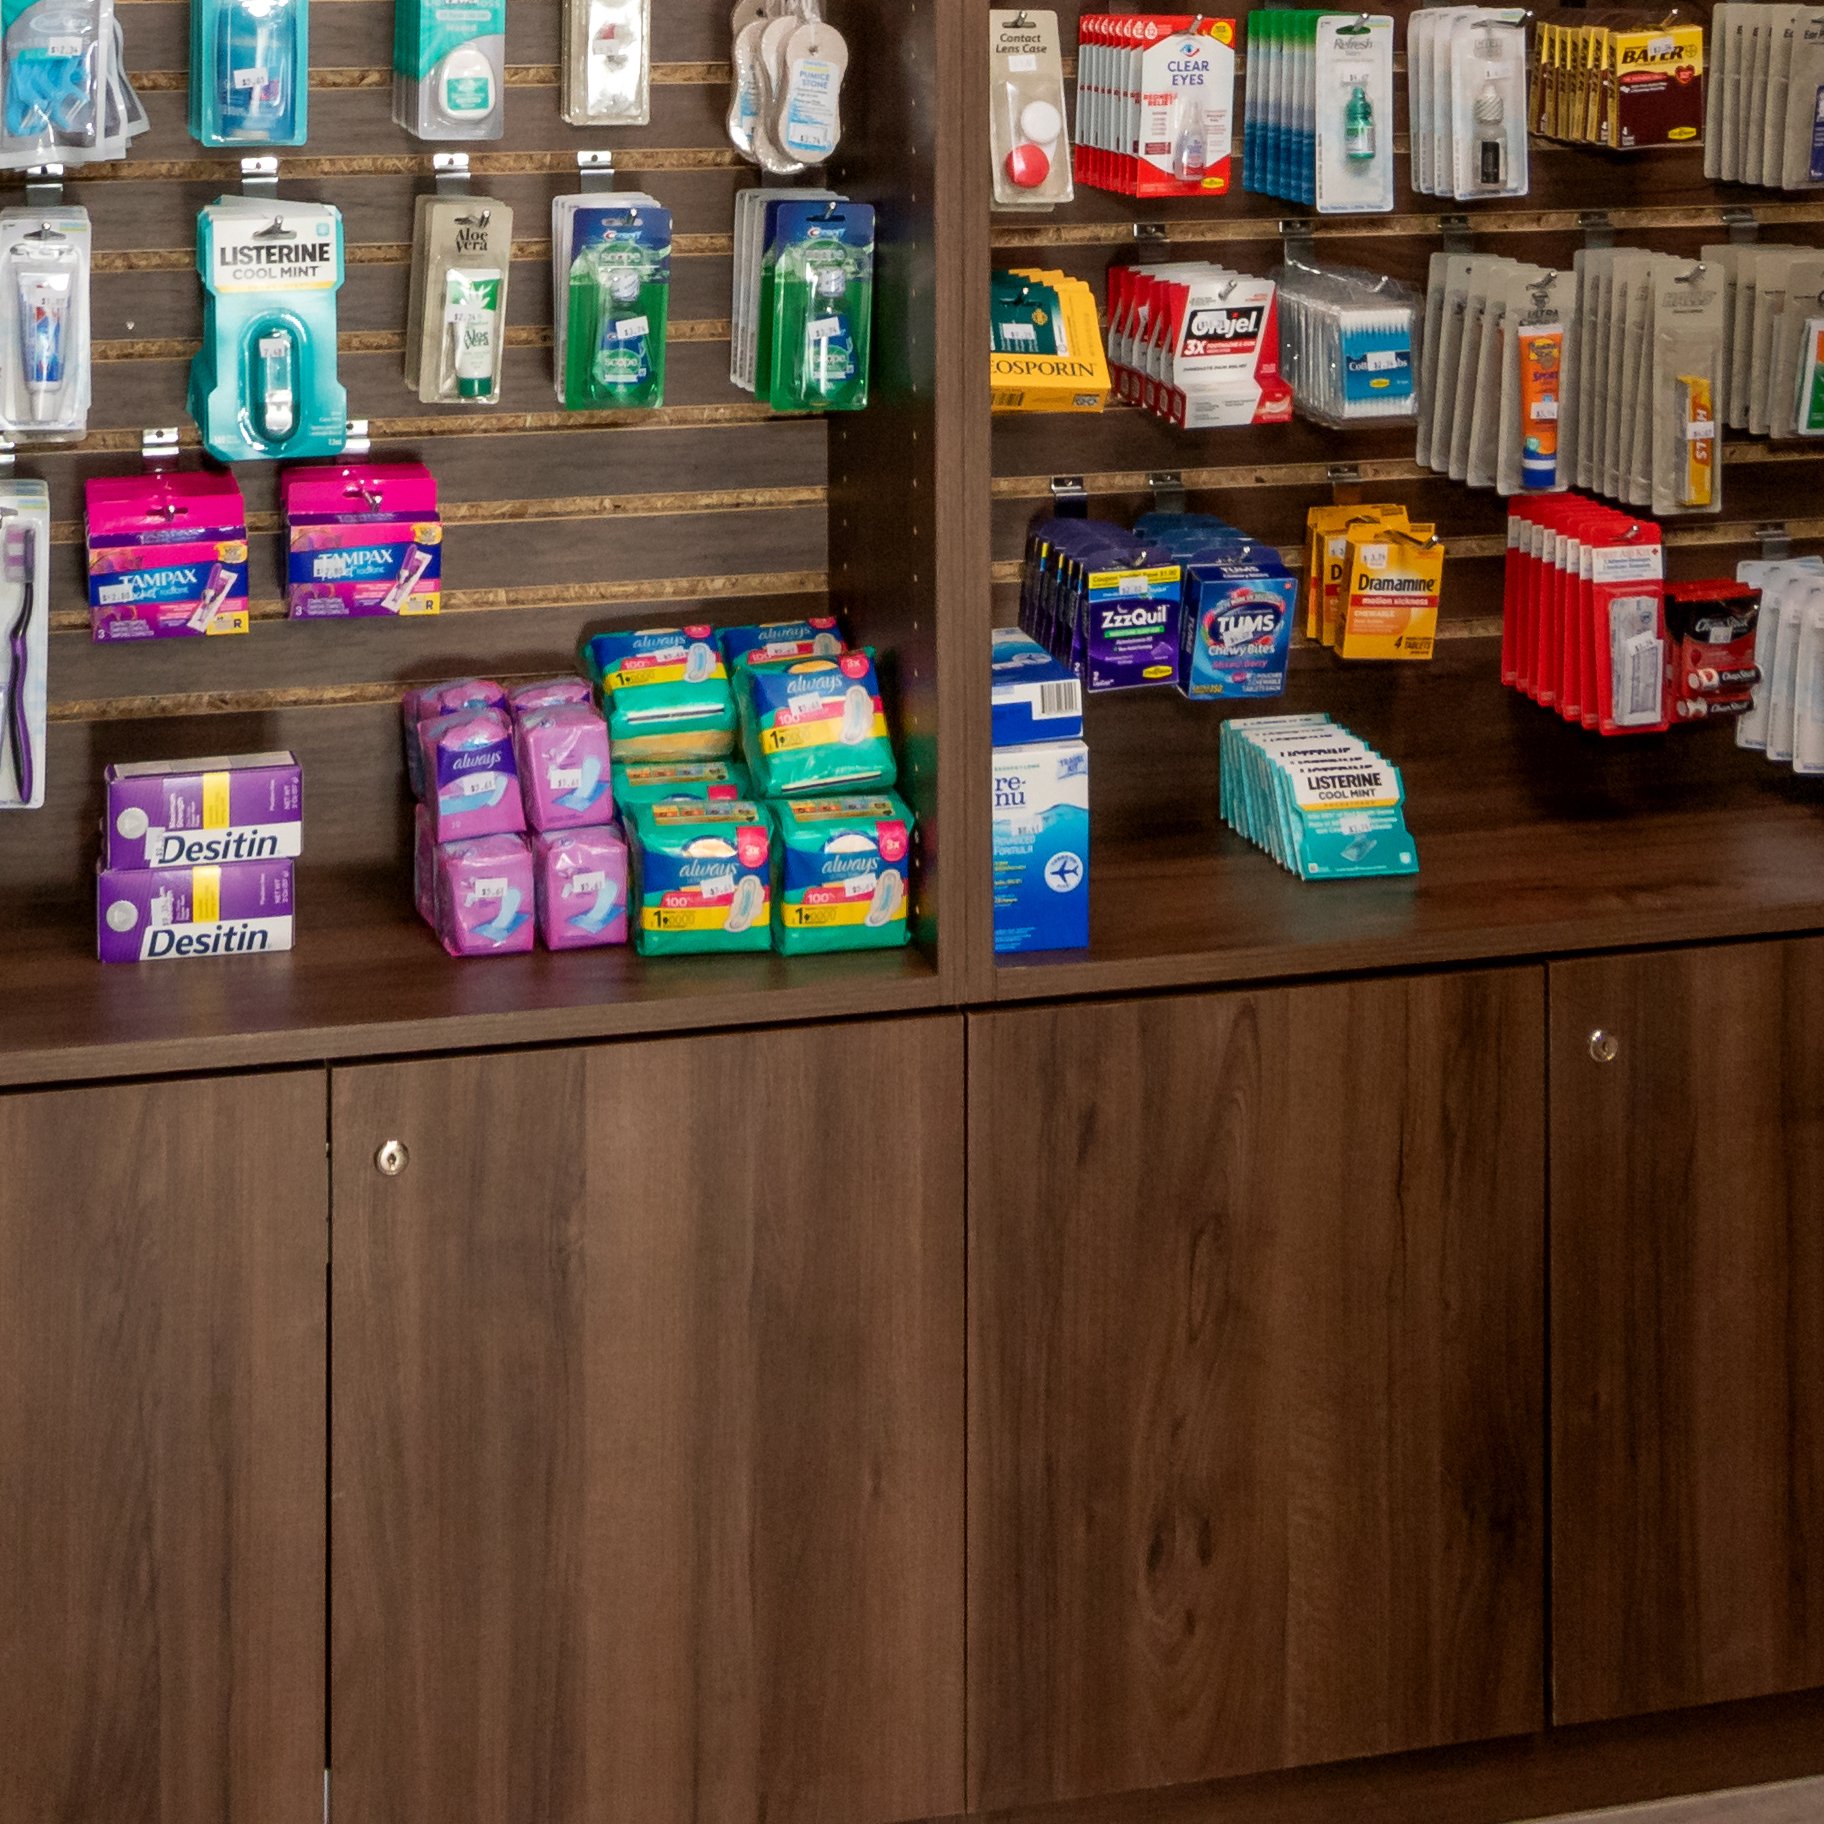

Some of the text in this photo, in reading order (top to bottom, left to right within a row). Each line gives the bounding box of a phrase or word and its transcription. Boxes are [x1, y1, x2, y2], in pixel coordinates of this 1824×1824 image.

[999, 33, 1042, 45] Contact
[1803, 29, 1818, 40] Ear
[995, 42, 1048, 55] Lens Case
[1332, 36, 1375, 52] Refresh
[1166, 59, 1210, 73] CLEAR
[798, 70, 830, 81] PUMICE
[1171, 73, 1205, 87] EYES
[801, 79, 829, 91] STONE
[456, 227, 489, 242] Aloe
[455, 239, 489, 253] Vera
[219, 242, 332, 267] LISTERINE
[232, 265, 320, 280] COOL MINT
[1184, 339, 1207, 356] 3X
[319, 548, 394, 566] TAMPAX
[118, 568, 198, 590] TAMPAX
[1330, 563, 1343, 581] D
[1358, 573, 1434, 594] Dramamine
[425, 600, 435, 611] R
[1362, 596, 1429, 607] motion sickness
[295, 605, 303, 616] 3
[1101, 606, 1167, 629] ZzzQuil
[1354, 610, 1395, 619] CHEWABLE
[233, 618, 243, 630] R
[1218, 616, 1275, 634] TUMS
[98, 629, 106, 640] 3
[632, 633, 687, 650] always
[758, 625, 812, 643] always
[1207, 642, 1276, 658] Chewy Bites
[1393, 637, 1403, 650] 4
[847, 657, 863, 671] 3x
[787, 673, 845, 696] always
[452, 750, 502, 771] always
[1307, 773, 1382, 790] LISTERINE
[994, 790, 1026, 807] nu
[1318, 788, 1376, 801] COOL MINT
[158, 829, 279, 865] Desitin
[743, 844, 761, 857] 3x
[884, 839, 899, 852] 3x
[994, 844, 1034, 855] FORMULA
[678, 861, 739, 880] always
[821, 856, 881, 875] always
[146, 923, 269, 958] Desitin
